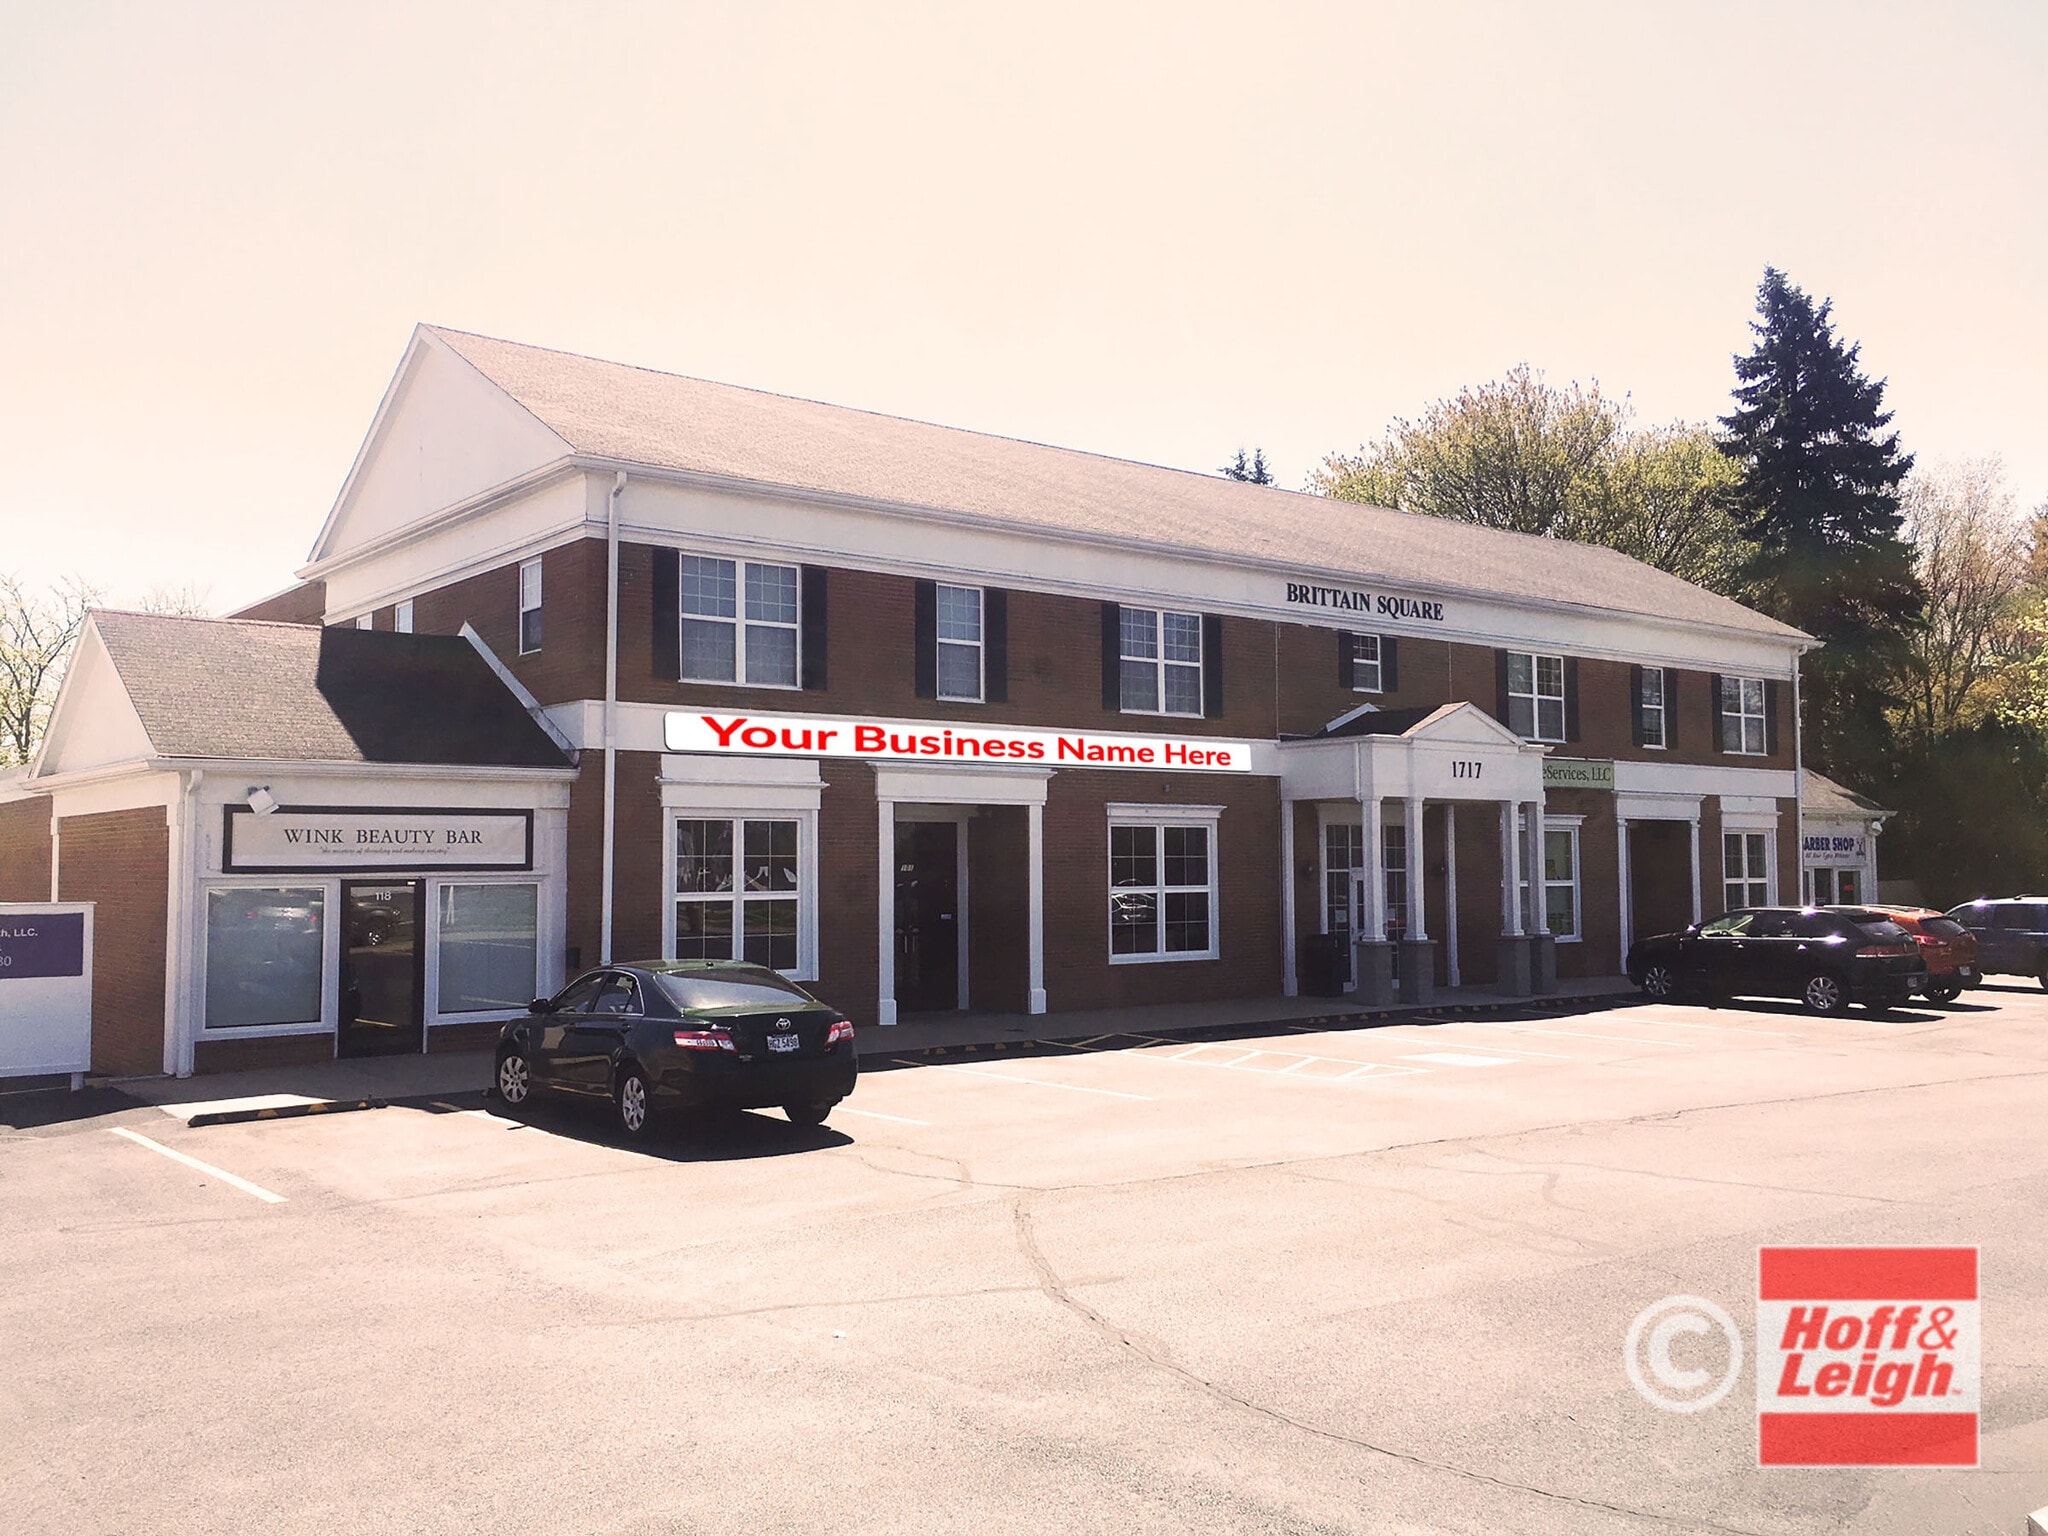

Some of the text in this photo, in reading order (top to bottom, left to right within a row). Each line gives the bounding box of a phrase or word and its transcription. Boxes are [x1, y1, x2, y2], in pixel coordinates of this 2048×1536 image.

[1287, 583, 1444, 621] BRITTAIN SQUARE
[1452, 761, 1482, 778] 1717
[1591, 767, 1611, 781] LLC
[284, 829, 483, 844] WINK BEAUTY BAR
[1803, 837, 1854, 851] ARBER SHOP
[375, 891, 391, 900] 118
[14, 928, 38, 937] LLC.
